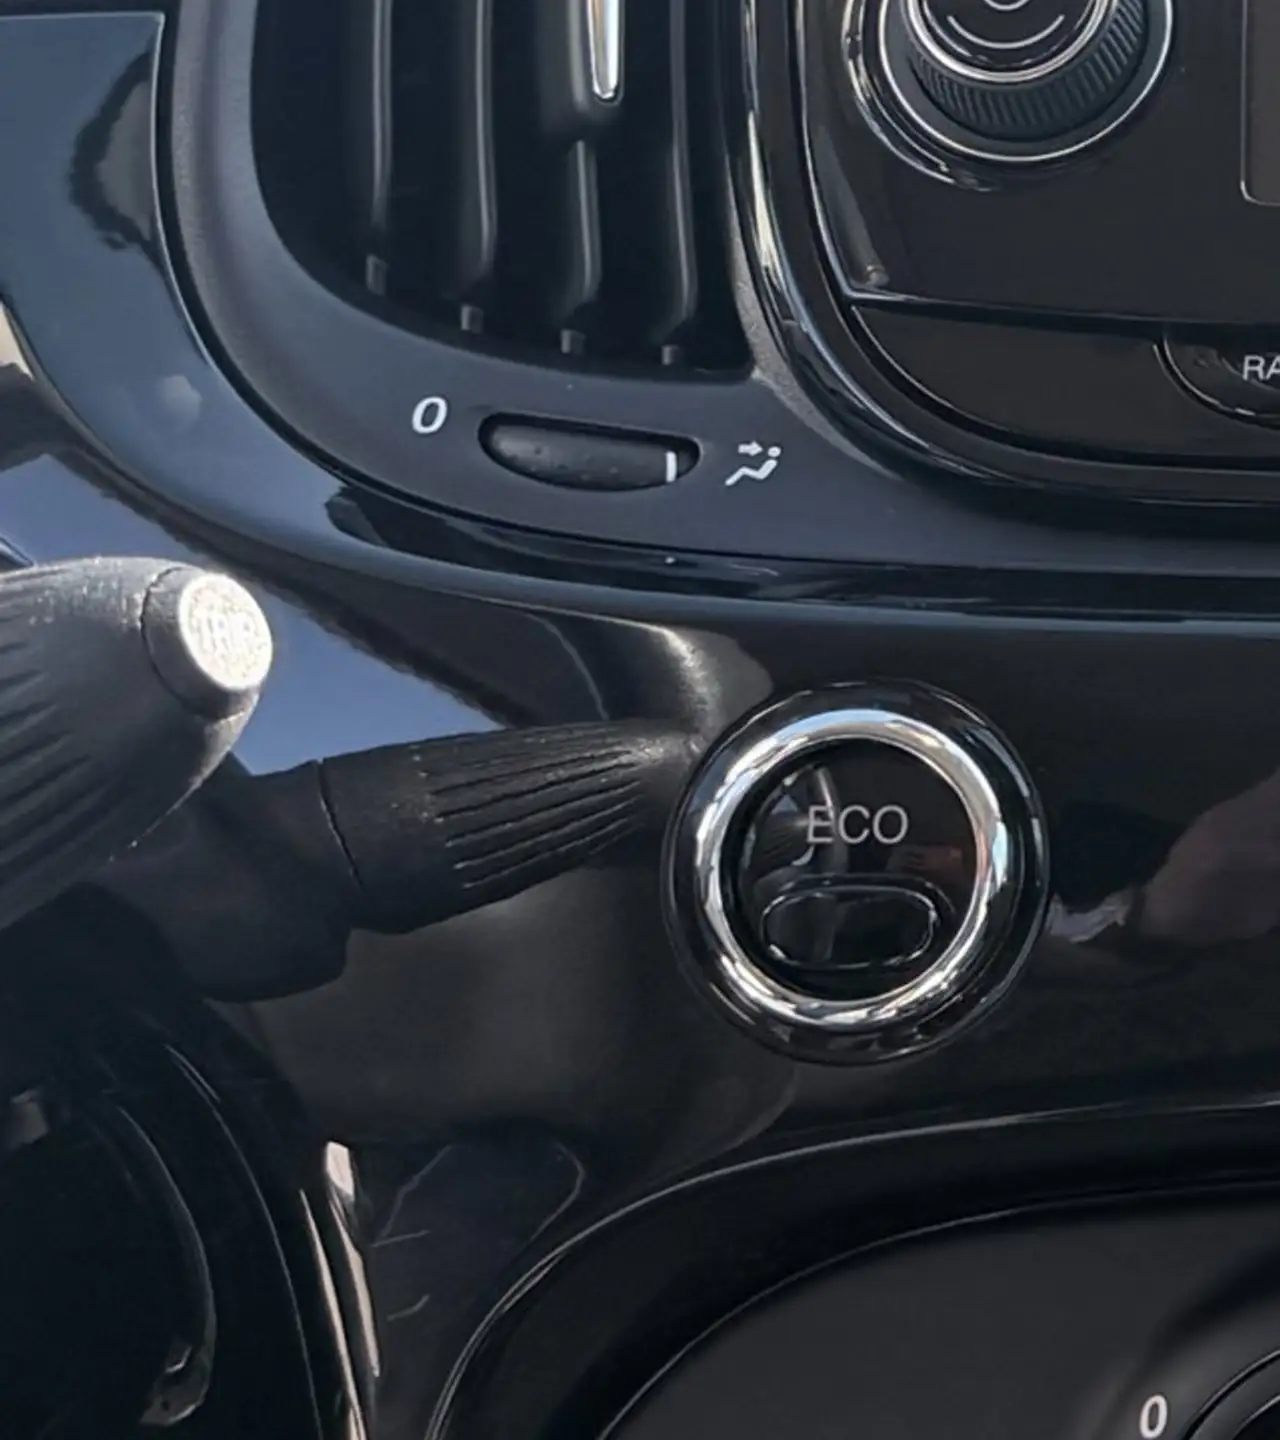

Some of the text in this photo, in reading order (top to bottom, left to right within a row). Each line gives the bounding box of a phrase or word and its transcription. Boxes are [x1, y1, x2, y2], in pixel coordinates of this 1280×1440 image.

[411, 396, 449, 434] 0
[806, 804, 909, 845] ECO
[1139, 1394, 1169, 1440] 0
